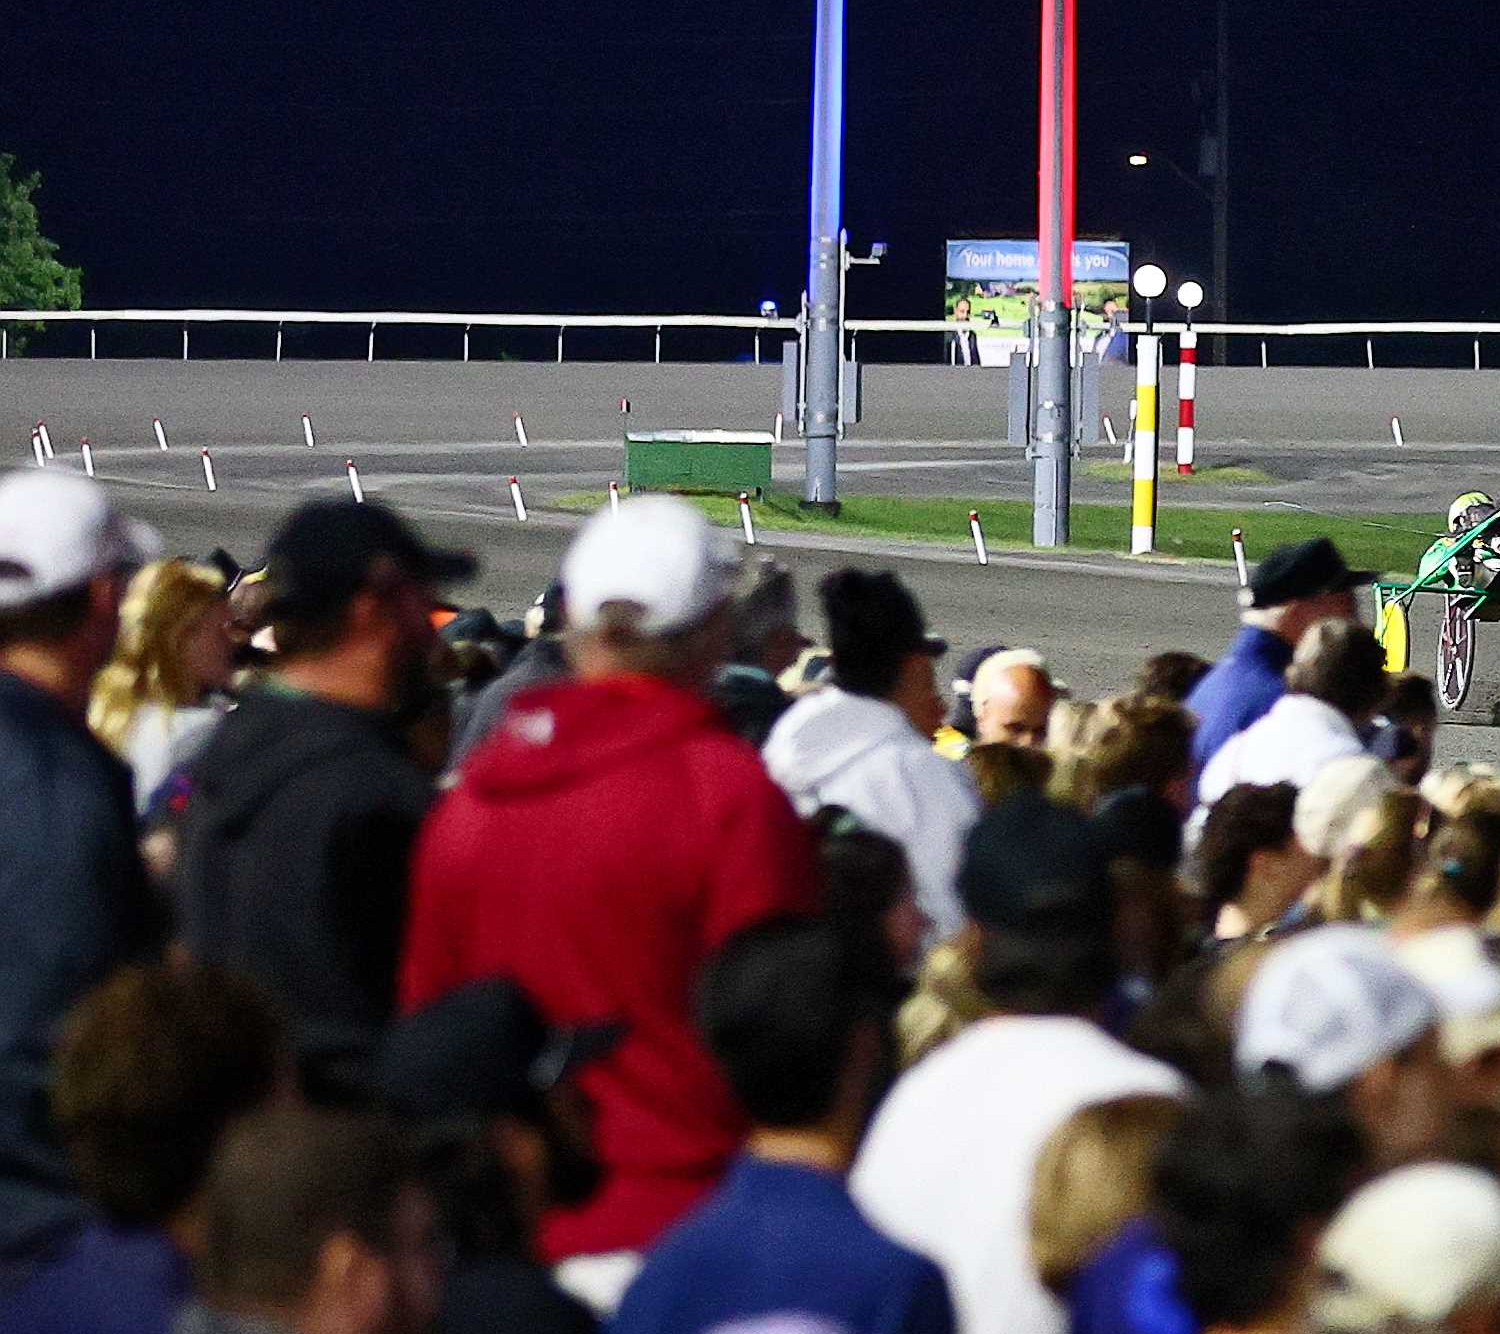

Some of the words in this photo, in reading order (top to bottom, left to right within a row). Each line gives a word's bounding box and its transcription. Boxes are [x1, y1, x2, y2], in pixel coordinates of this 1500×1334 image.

[965, 250, 992, 267] Your
[996, 251, 1034, 267] home
[1085, 255, 1109, 271] you
